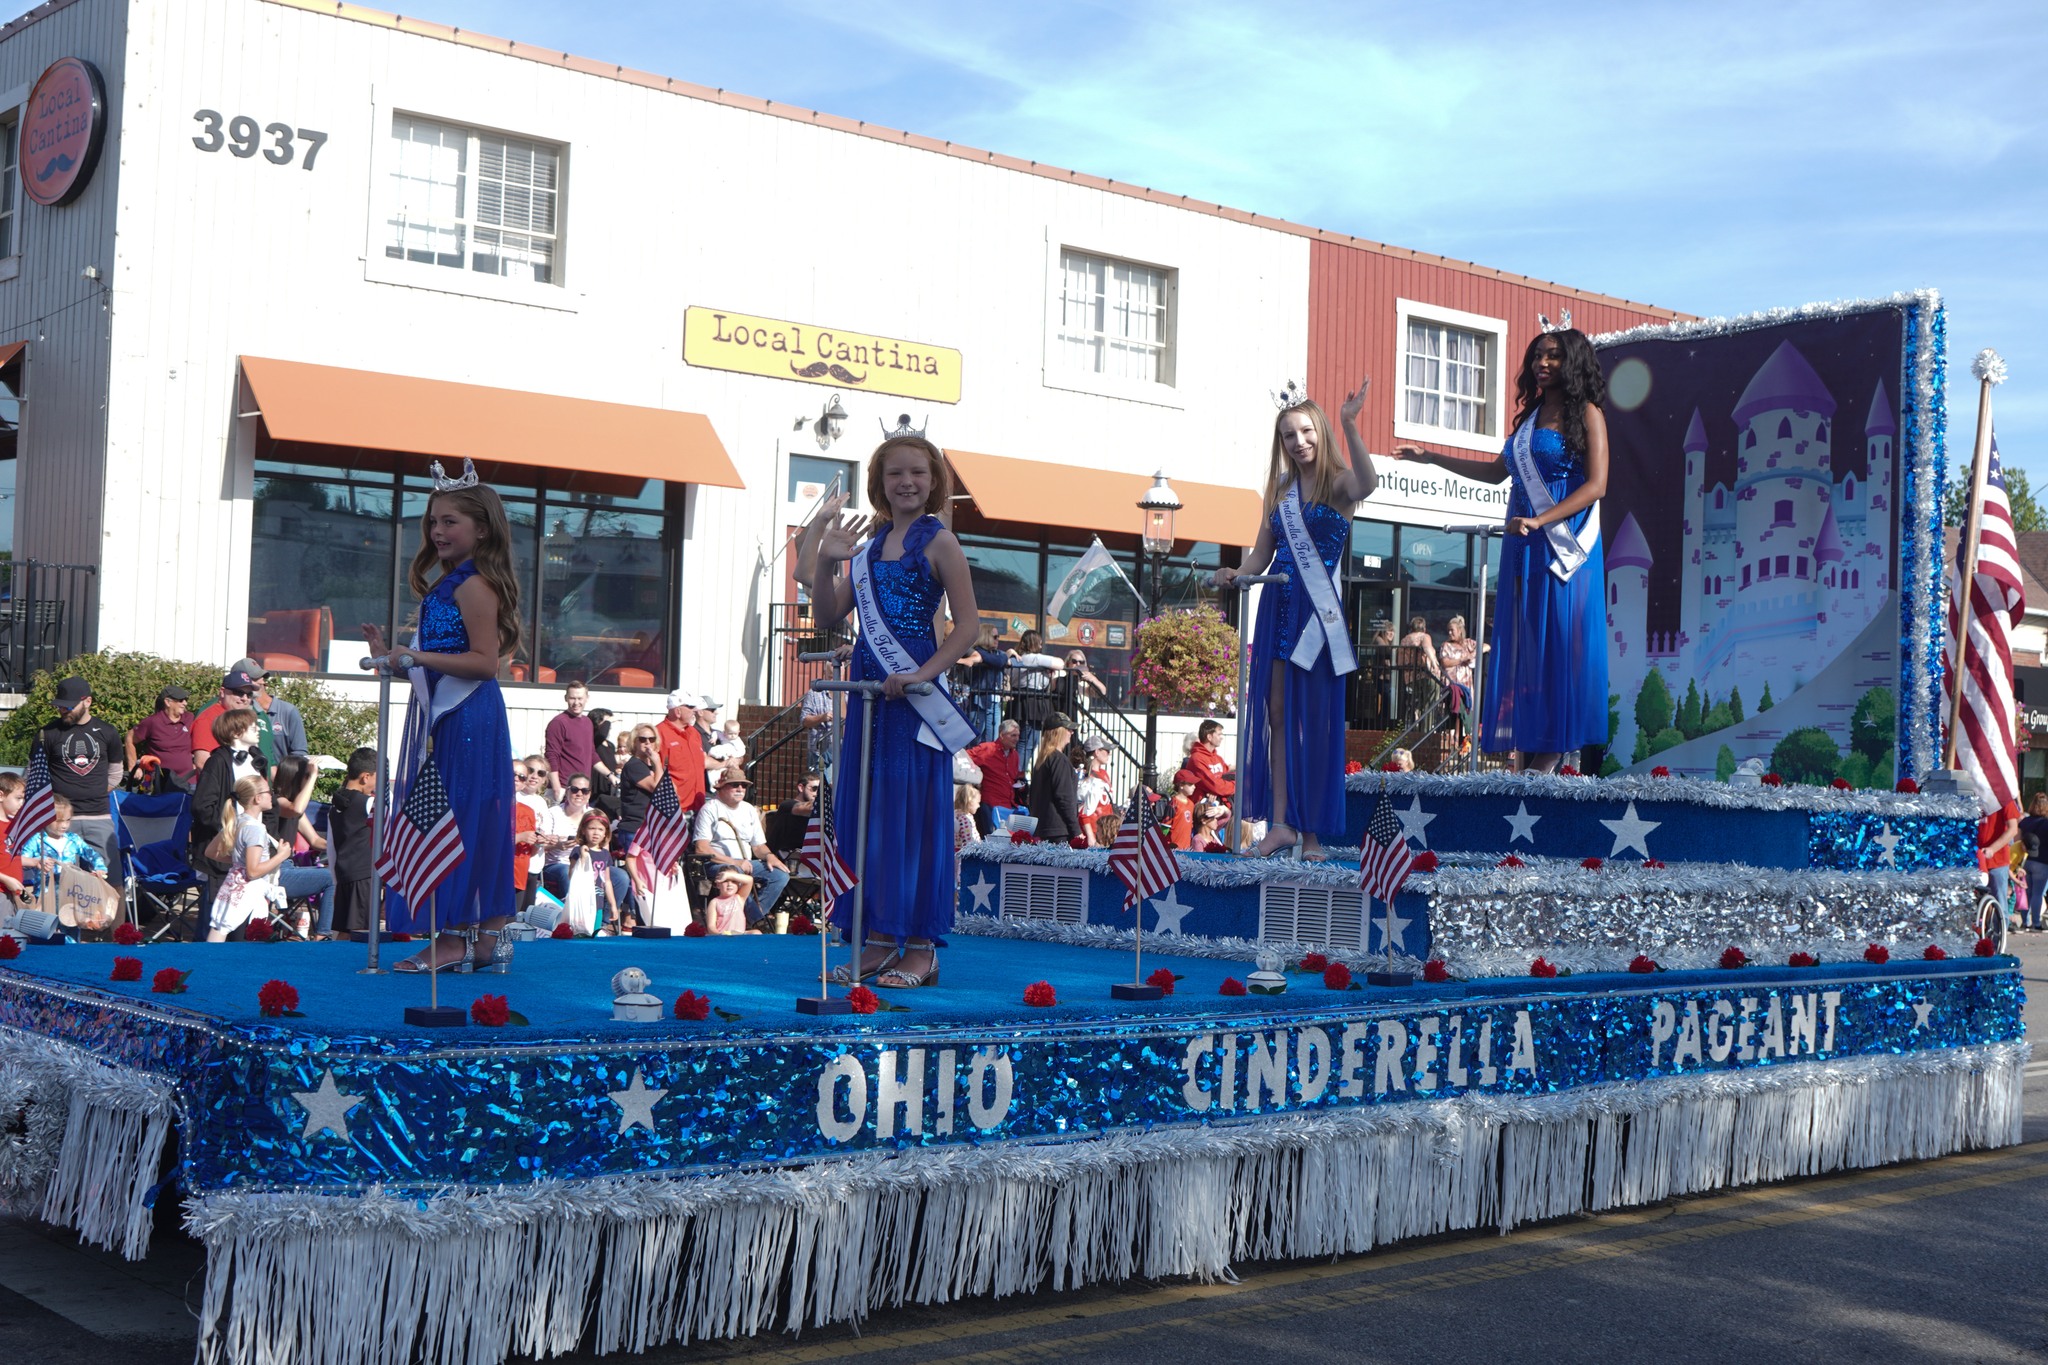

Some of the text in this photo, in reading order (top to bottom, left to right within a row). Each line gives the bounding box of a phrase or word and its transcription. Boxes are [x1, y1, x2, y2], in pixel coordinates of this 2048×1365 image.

[39, 77, 81, 119] Local
[29, 111, 88, 155] Cantina
[191, 108, 329, 172] 3937
[712, 314, 940, 376] Local Cantina
[1376, 471, 1511, 505] ntiques-Mercant
[1293, 540, 1311, 571] Teen
[1412, 542, 1432, 557] OPEN
[855, 572, 912, 675] Cinderella Talent
[1077, 604, 1096, 613] OPEN
[66, 884, 102, 908] Kroger
[816, 991, 1841, 1143] OHIO CINDERELLA PAGEANT
